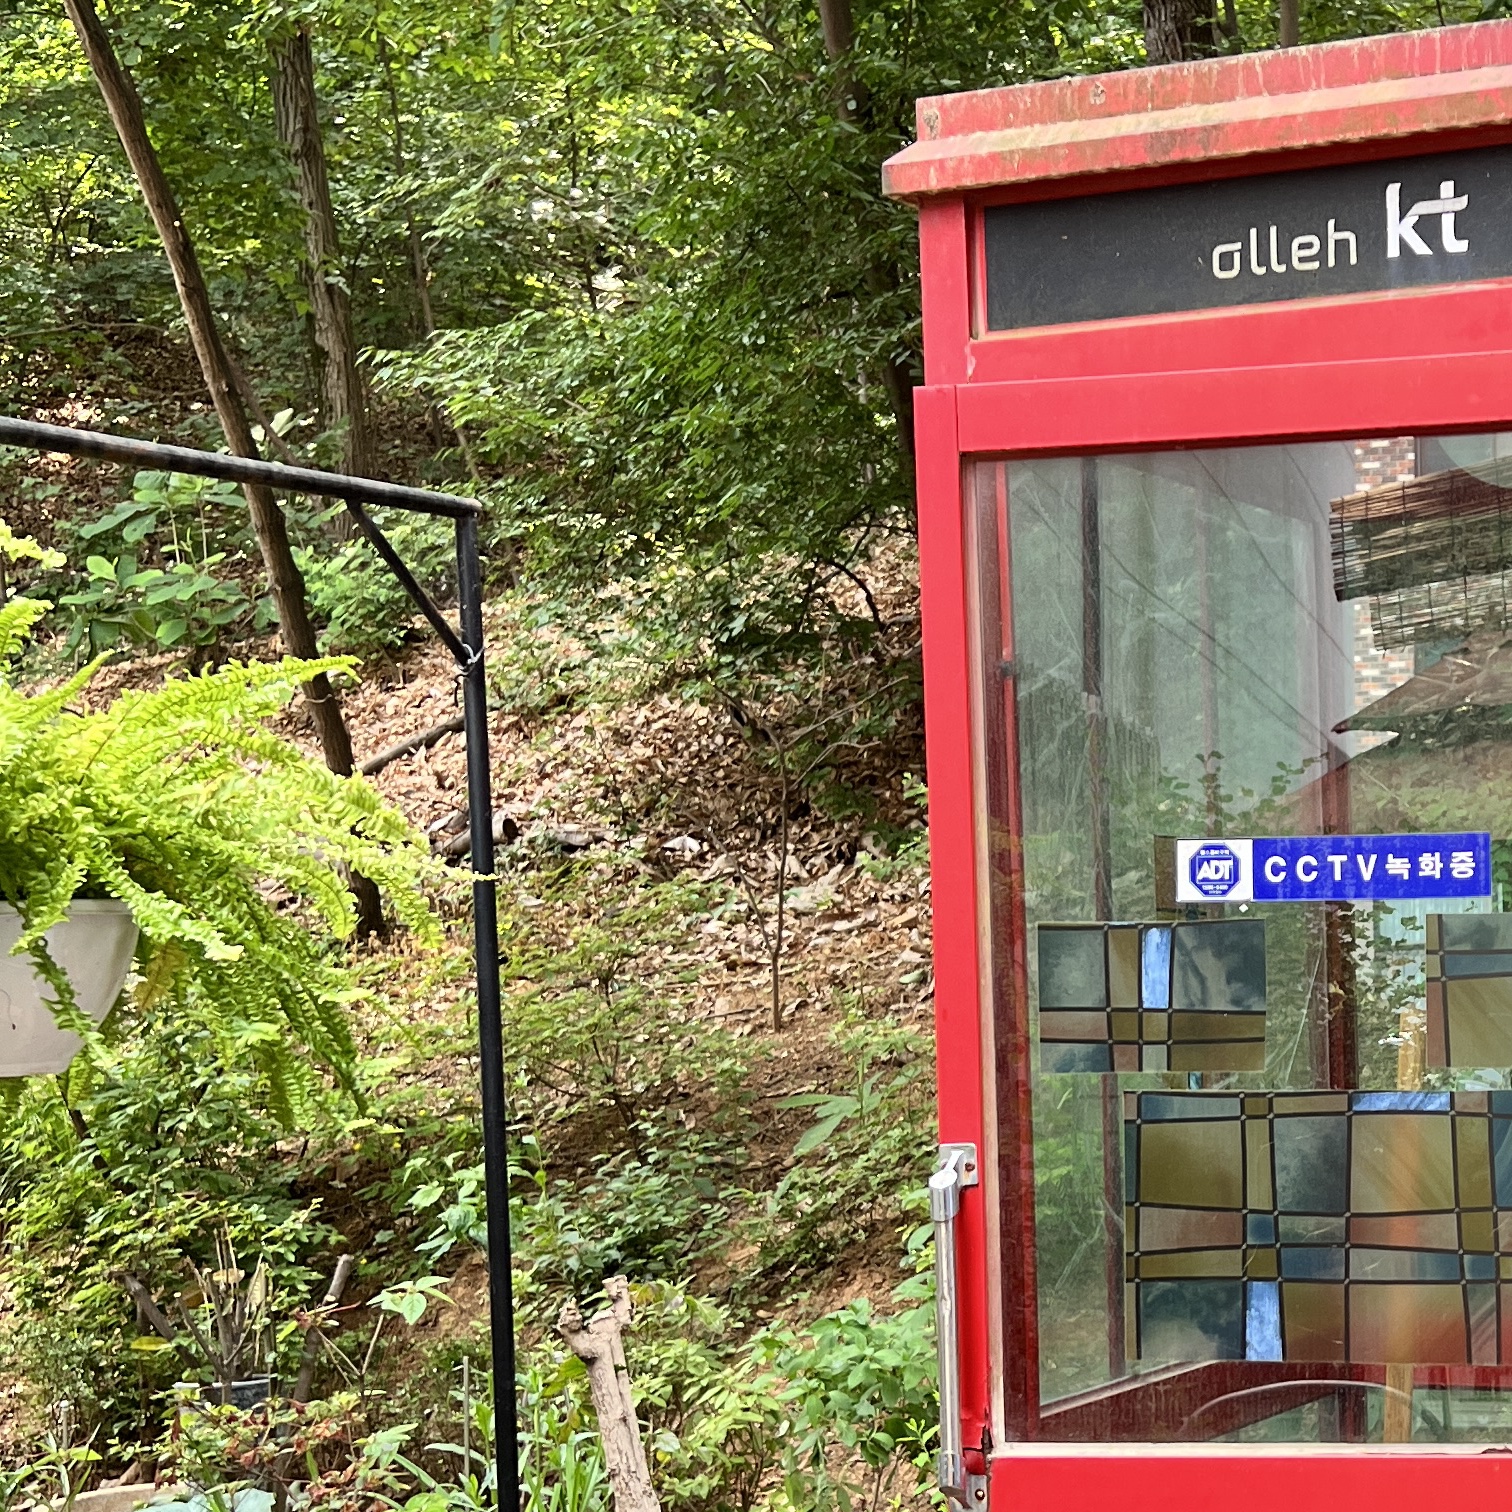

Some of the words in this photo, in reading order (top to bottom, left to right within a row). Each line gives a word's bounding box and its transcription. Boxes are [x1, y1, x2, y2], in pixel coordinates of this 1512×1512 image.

[1211, 219, 1357, 280] olleh
[1386, 180, 1470, 259] kt
[1196, 860, 1233, 880] ADT
